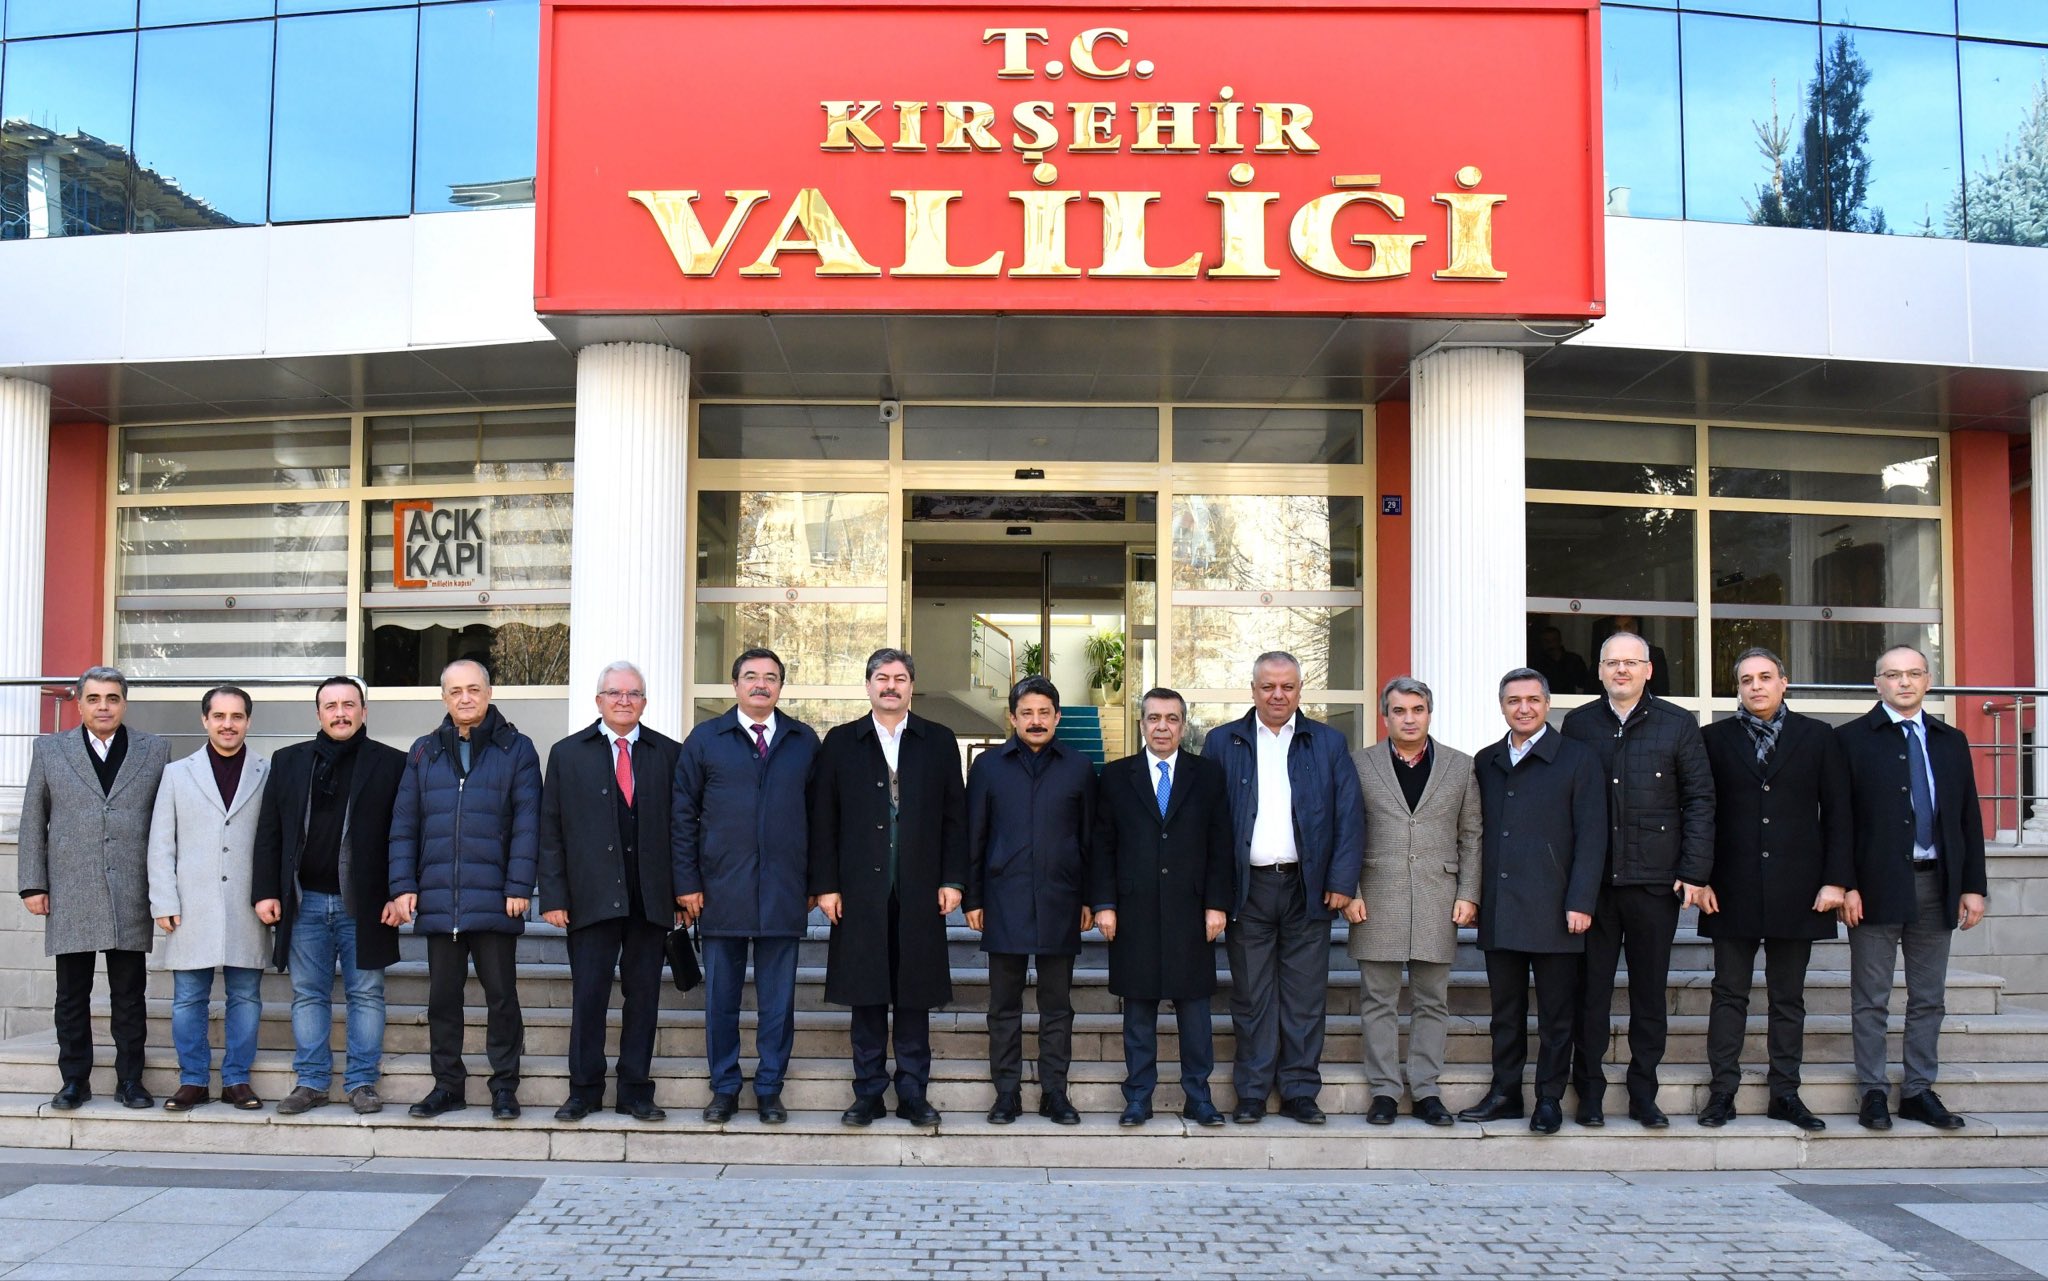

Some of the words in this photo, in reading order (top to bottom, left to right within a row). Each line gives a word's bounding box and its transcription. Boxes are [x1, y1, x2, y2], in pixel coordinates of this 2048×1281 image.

[982, 27, 1155, 80] T.C.
[820, 86, 1321, 164] KIRŞEHİR
[627, 161, 1509, 281] VALİLİĞİ
[406, 508, 484, 546] AÇIK
[1387, 501, 1396, 509] 29
[405, 542, 483, 577] KAPI
